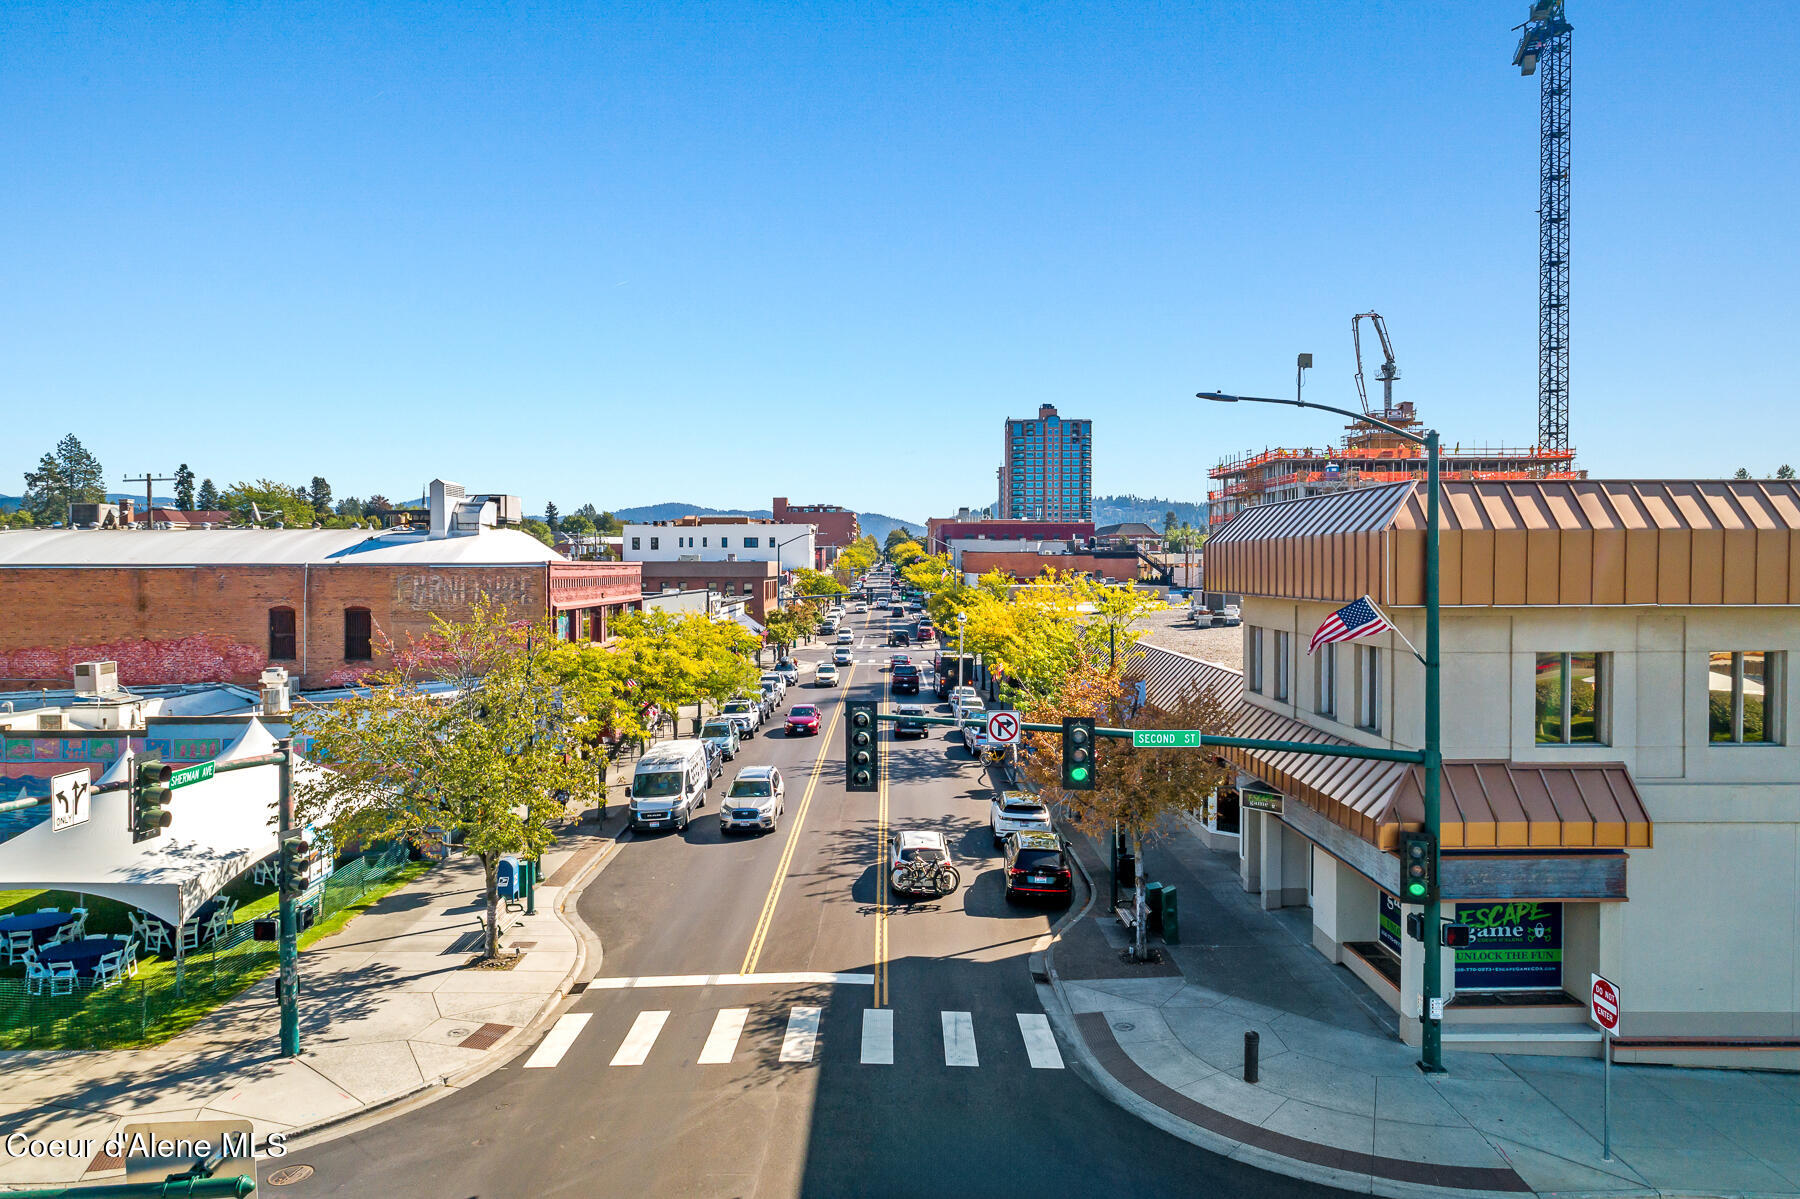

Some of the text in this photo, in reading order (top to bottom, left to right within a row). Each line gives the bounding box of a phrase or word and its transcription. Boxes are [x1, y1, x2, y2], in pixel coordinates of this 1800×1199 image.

[1138, 734, 1196, 744] SECOND ST
[171, 766, 213, 787] SHERMAN AVE
[56, 815, 72, 826] ONLY
[1458, 902, 1552, 928] ESCAPE
[1468, 926, 1524, 943] game
[1456, 951, 1554, 961] UNLOCK THE FUN
[1595, 985, 1615, 1003] DO NOT
[1597, 1006, 1614, 1022] ENTER
